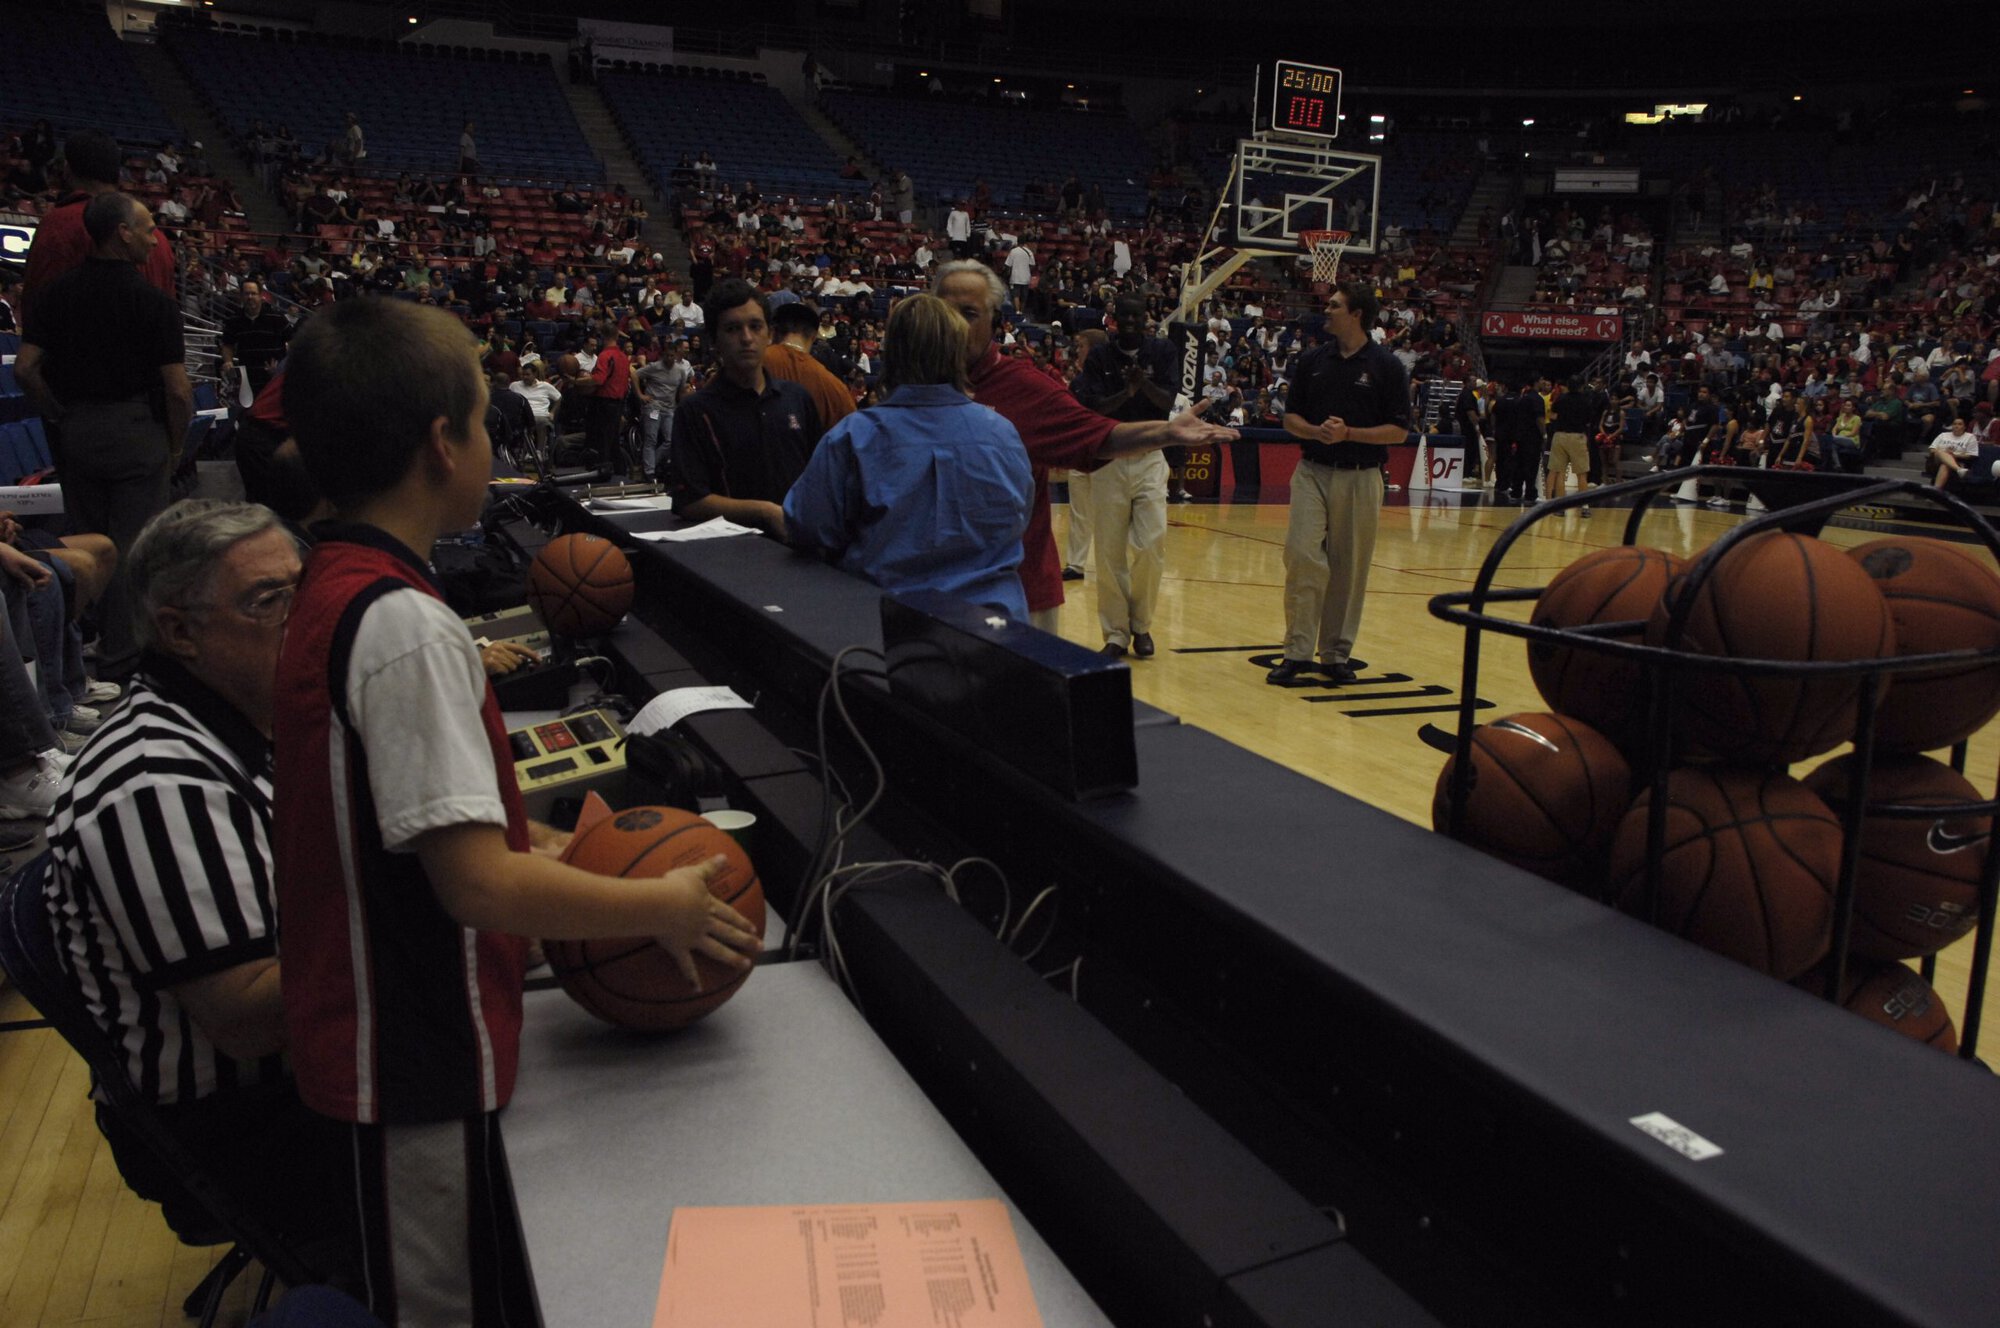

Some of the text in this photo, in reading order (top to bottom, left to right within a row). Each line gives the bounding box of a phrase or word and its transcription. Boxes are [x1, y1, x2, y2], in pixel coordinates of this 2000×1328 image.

[1283, 68, 1334, 93] 25:00
[1288, 96, 1325, 128] 00
[1511, 324, 1589, 336] do you need?
[1522, 314, 1580, 326] What else
[1181, 329, 1199, 407] ARIZON
[1432, 457, 1463, 479] OF
